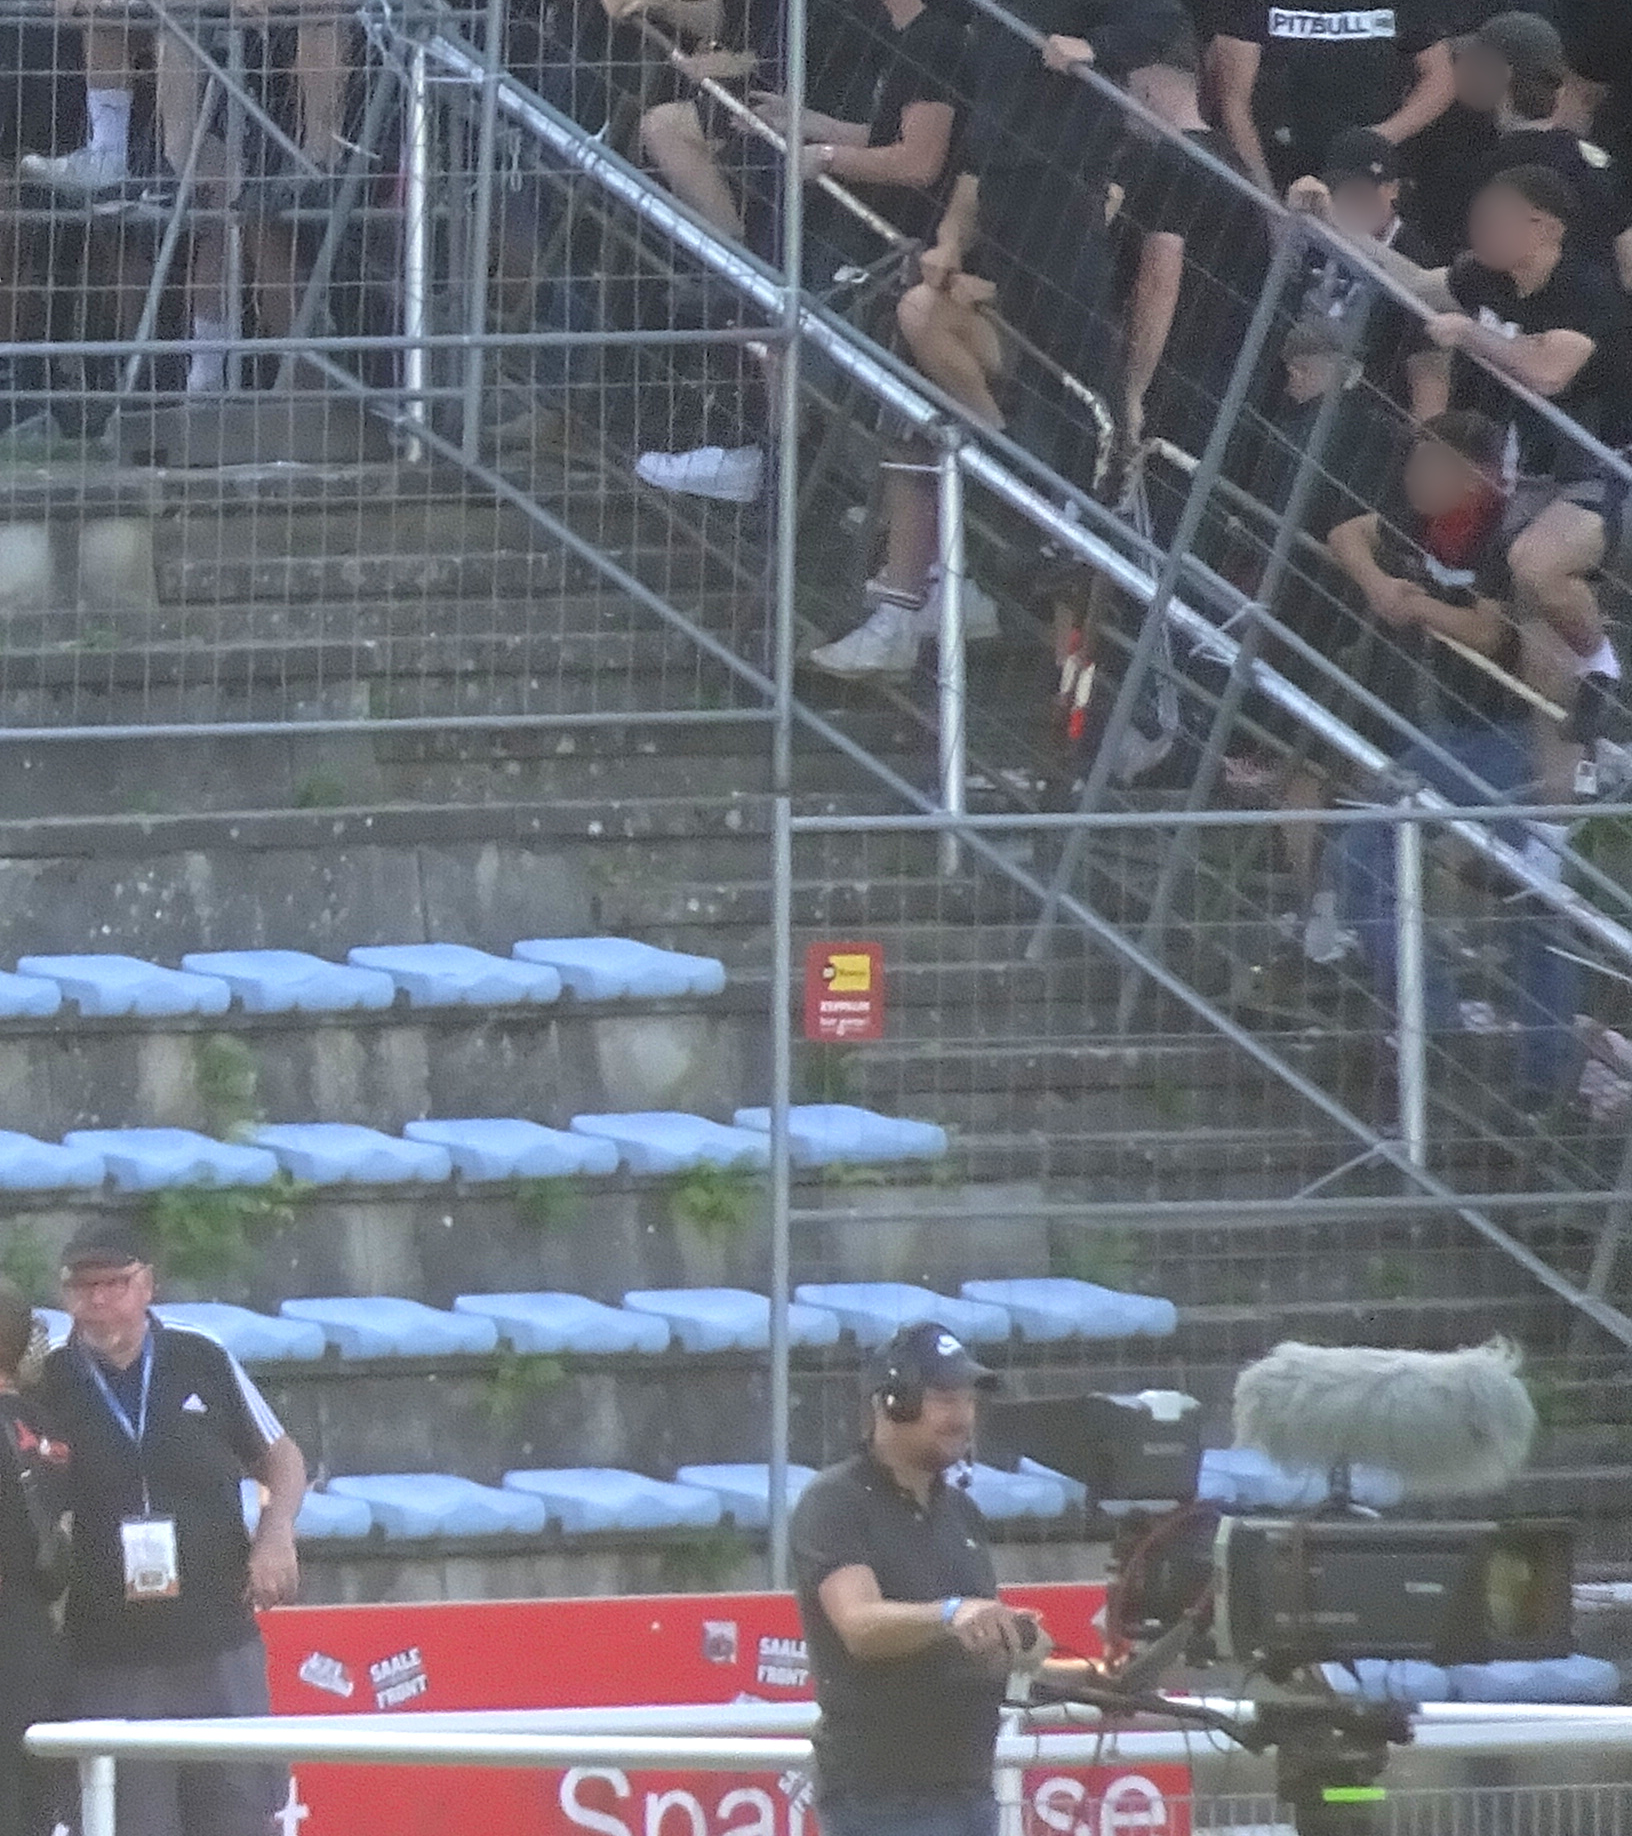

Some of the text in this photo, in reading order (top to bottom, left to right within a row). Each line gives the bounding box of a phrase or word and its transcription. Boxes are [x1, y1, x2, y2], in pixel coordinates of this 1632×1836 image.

[1273, 16, 1369, 34] PITBULL
[370, 1647, 422, 1682] SAALE
[376, 1674, 427, 1709] FRONT
